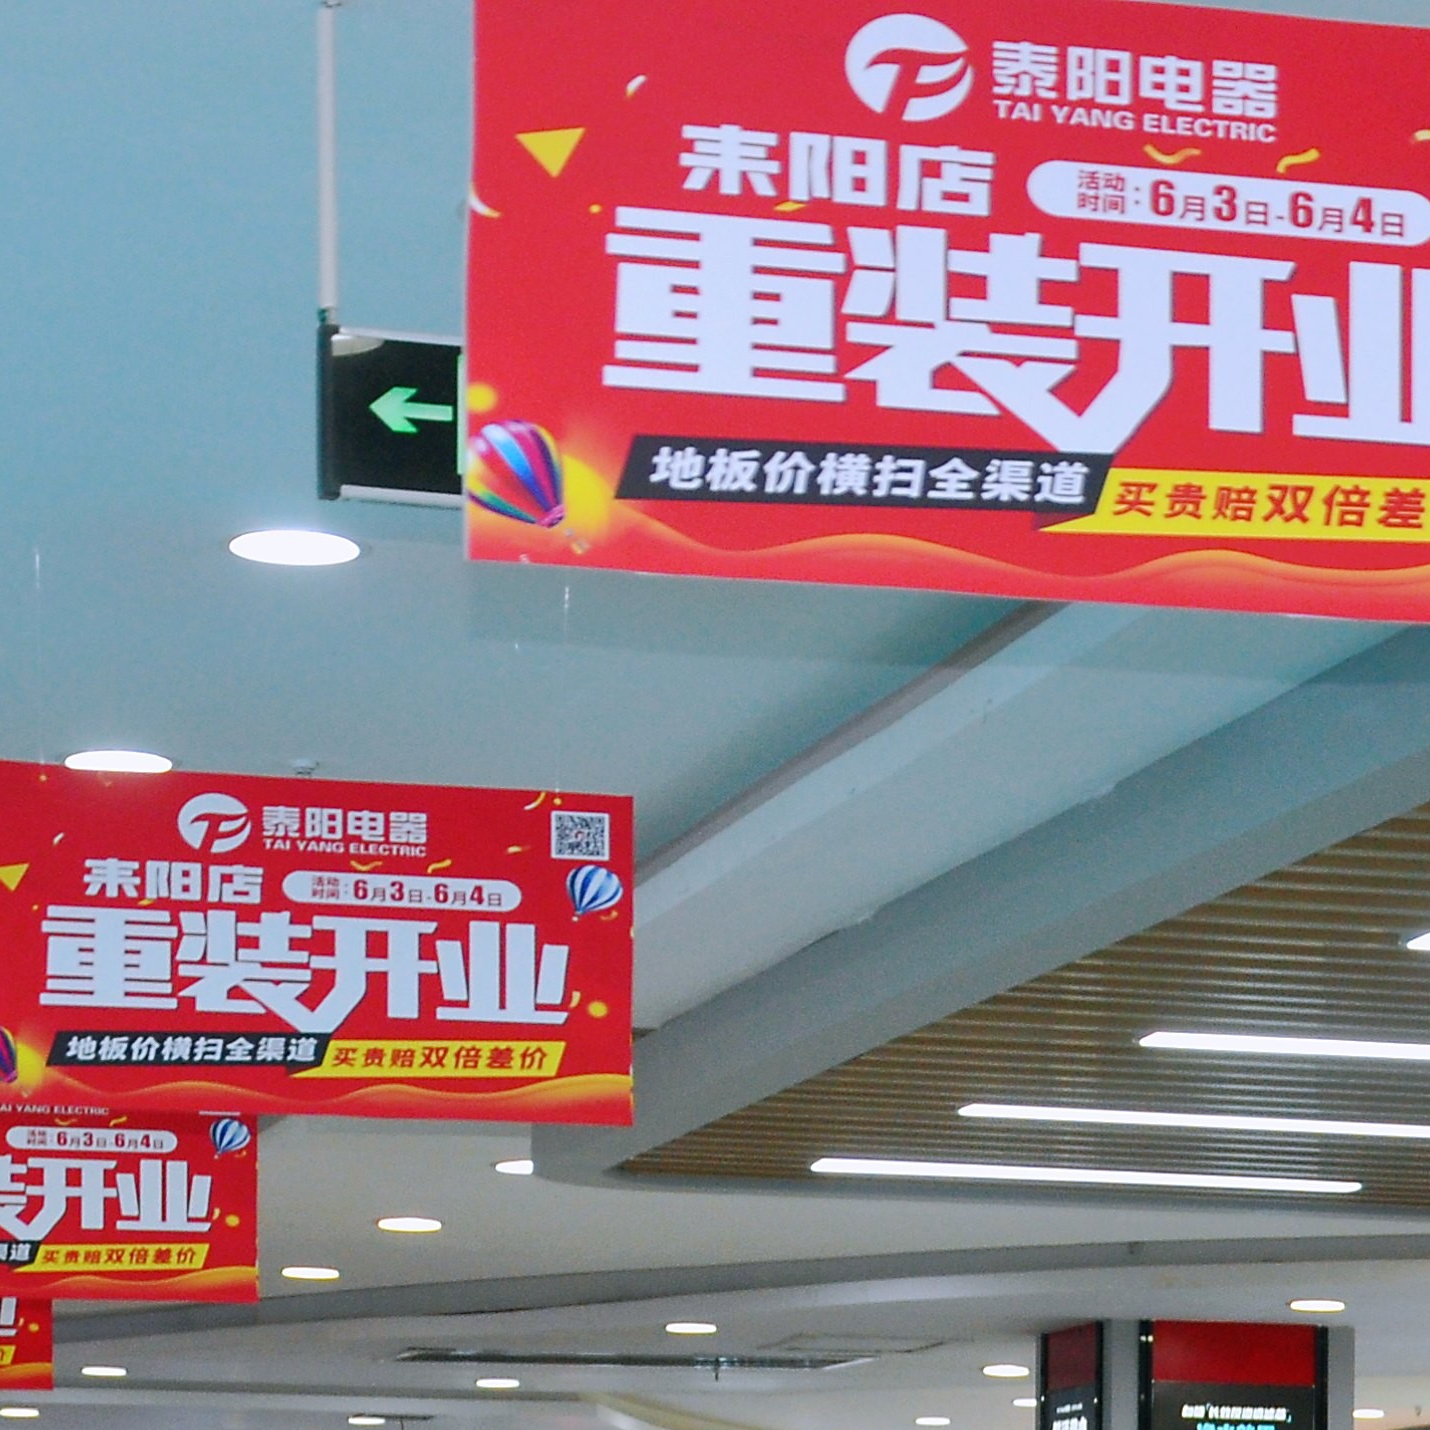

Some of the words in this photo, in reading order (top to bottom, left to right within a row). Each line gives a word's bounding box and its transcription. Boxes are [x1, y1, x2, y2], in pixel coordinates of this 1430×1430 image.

[992, 40, 1278, 119] 泰阳电器
[992, 99, 1041, 122] TAI
[1051, 104, 1136, 132] YANG
[1142, 114, 1277, 143] ELECTRIC
[678, 122, 997, 218] 耒阳店
[1076, 169, 1125, 192] 活动
[1076, 191, 1126, 215] 时间
[647, 444, 1090, 507] 地板价横扫全渠道
[262, 805, 428, 844] 泰阳电器
[263, 838, 291, 850] TAI
[296, 841, 345, 854] YANG
[349, 843, 427, 857] ELECTRIC
[82, 857, 265, 904] 耒阳店
[38, 904, 570, 1034] 重装开业
[65, 1034, 317, 1063] 地板价横扫全渠道
[332, 1044, 549, 1072] 买贵赔双倍差价
[16, 1104, 50, 1114] YANG
[54, 1105, 110, 1116] ELECTRIC
